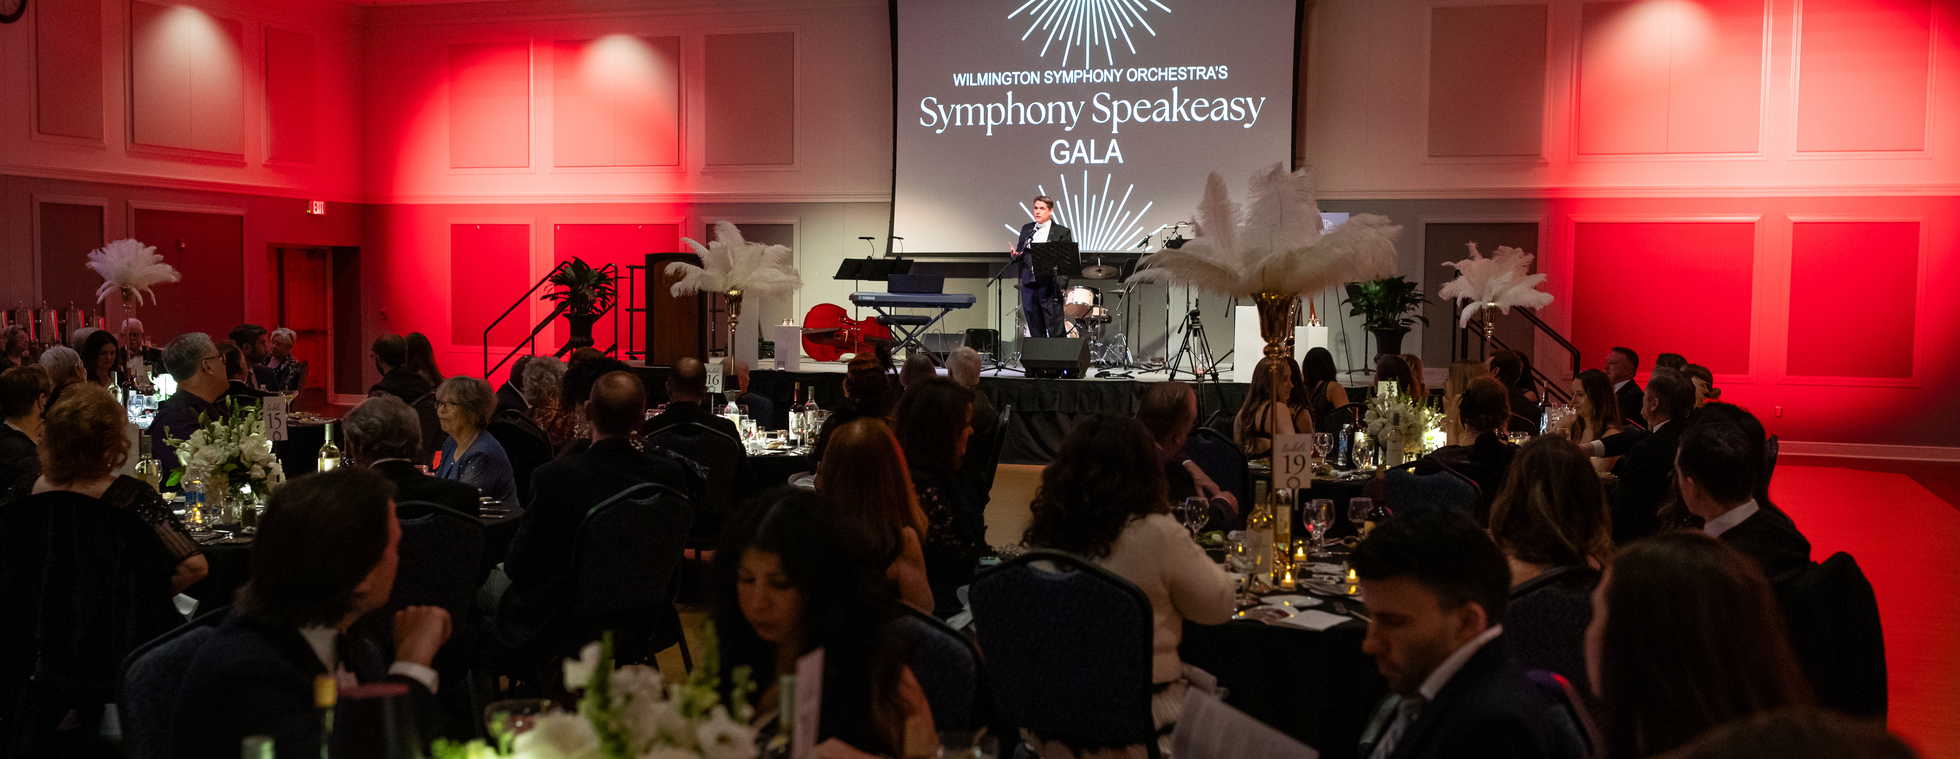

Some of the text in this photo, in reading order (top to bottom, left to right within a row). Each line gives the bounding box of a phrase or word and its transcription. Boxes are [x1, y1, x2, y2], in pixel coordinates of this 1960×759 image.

[953, 65, 1229, 86] WILMINGTON SYMPHONY ORCHESTRA’S
[919, 86, 1266, 136] Symphony Speakeasy
[1050, 138, 1124, 164] GALA
[313, 200, 324, 215] EXIT
[708, 374, 720, 386] 16
[268, 412, 282, 431] 15
[1284, 454, 1306, 476] 19
